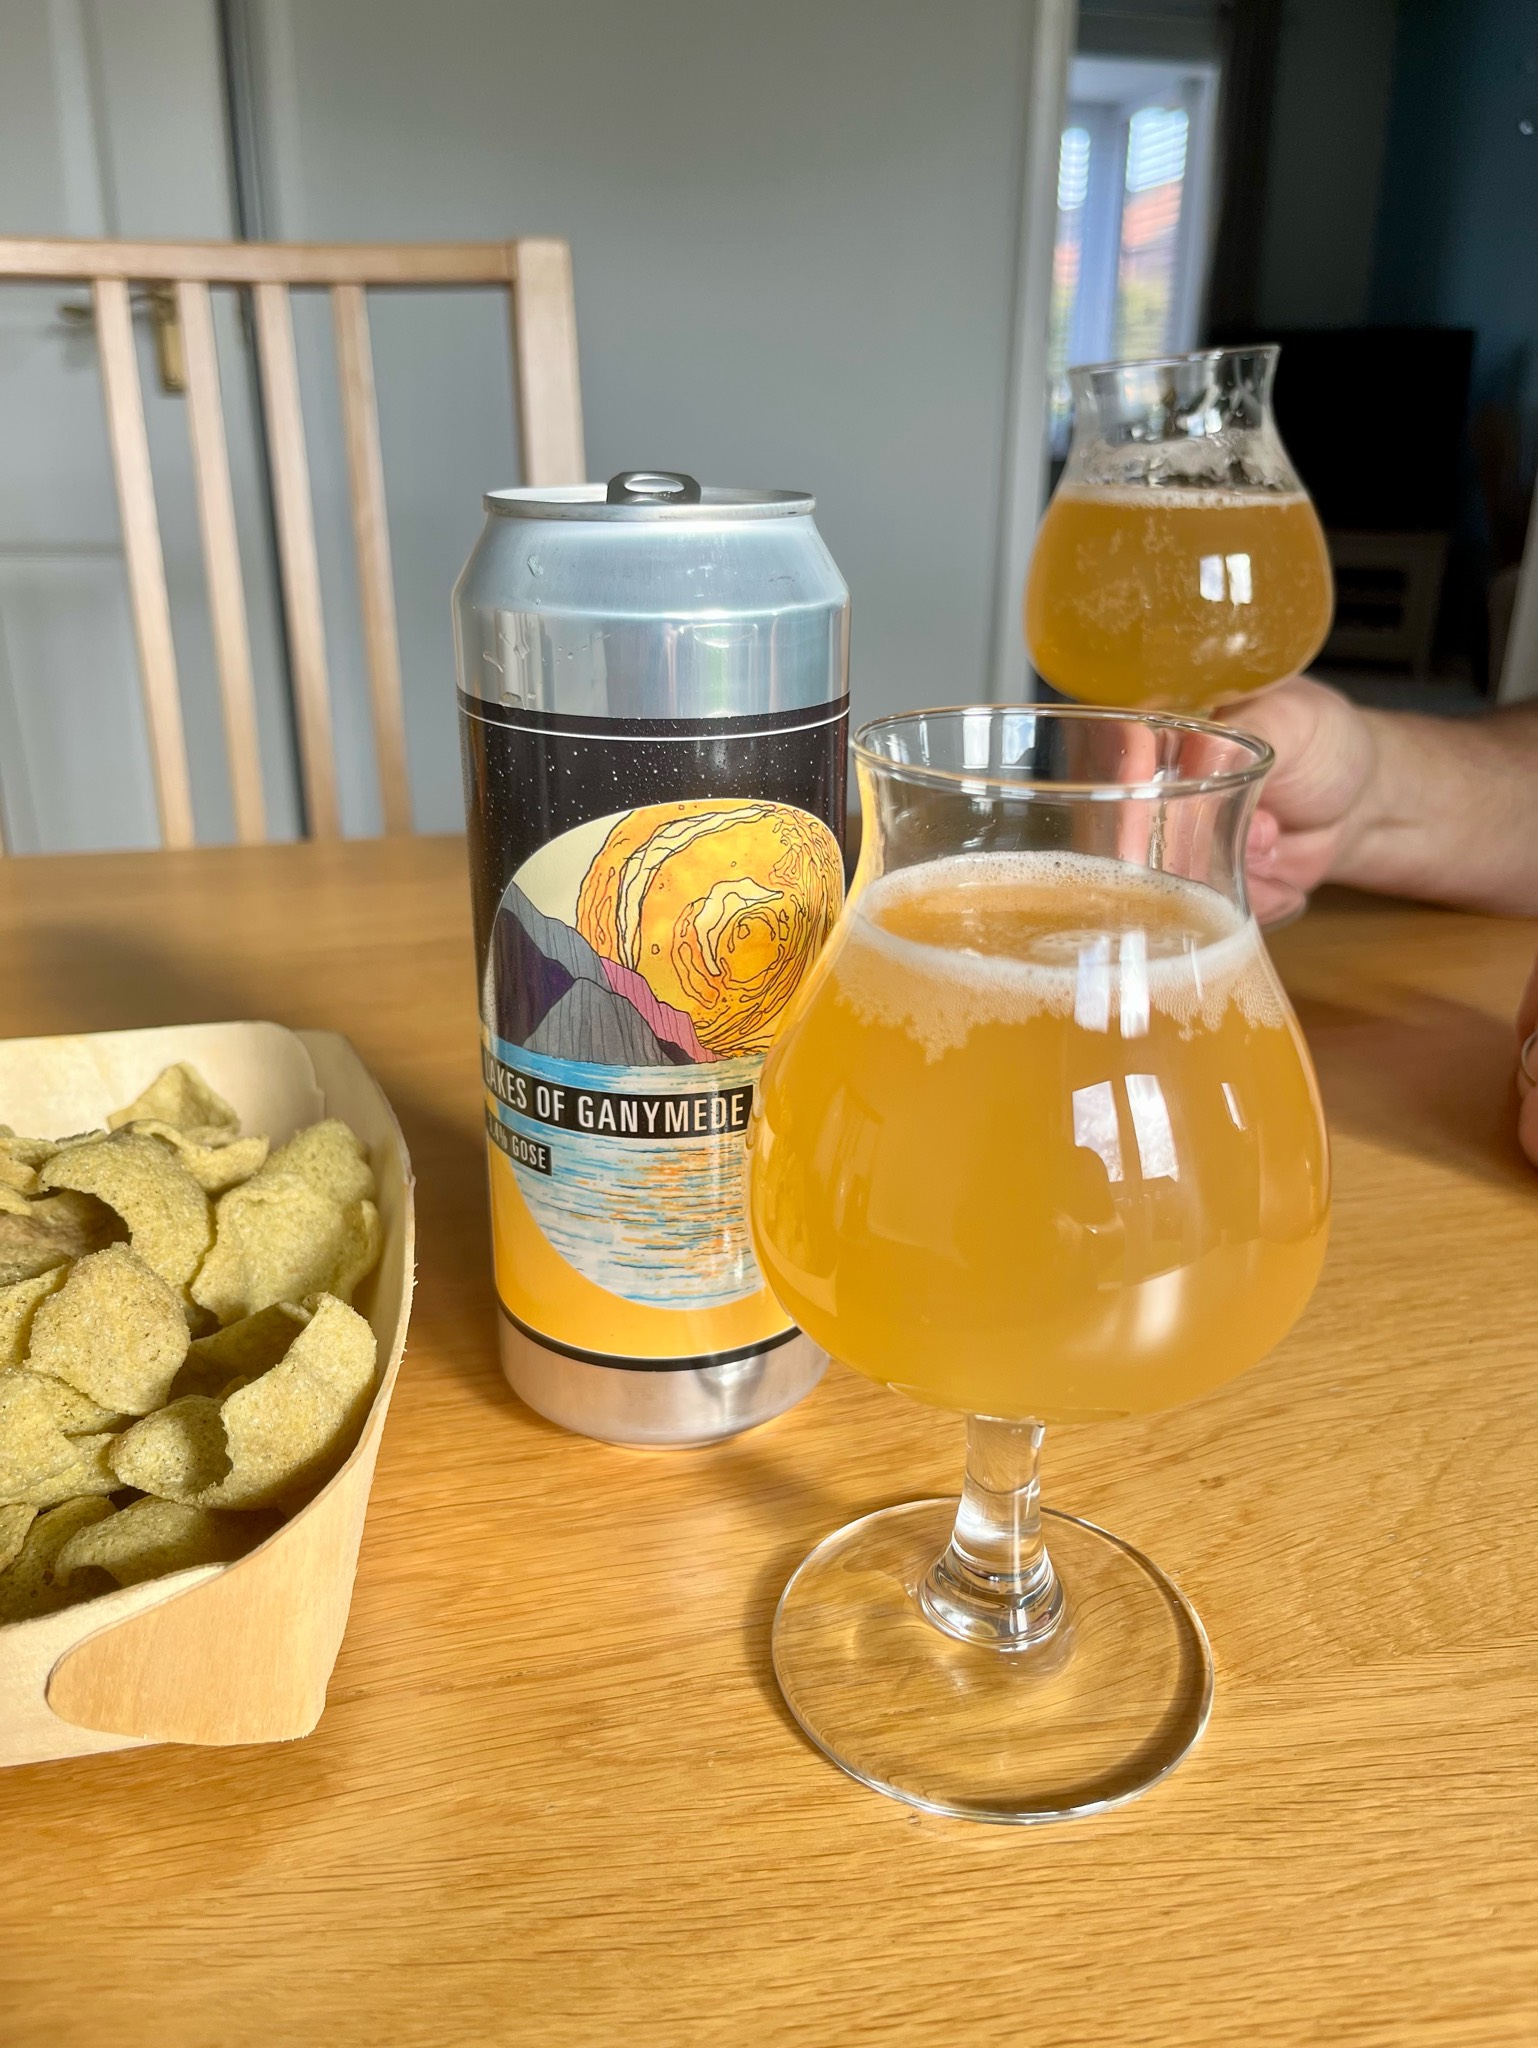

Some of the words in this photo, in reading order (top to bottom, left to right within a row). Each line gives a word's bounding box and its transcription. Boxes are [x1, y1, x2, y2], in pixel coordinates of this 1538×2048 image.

[484, 1050, 527, 1109] LAKES
[536, 1085, 565, 1121] OF
[578, 1094, 744, 1133] GANYMEDE
[512, 1135, 546, 1169] GOSE
